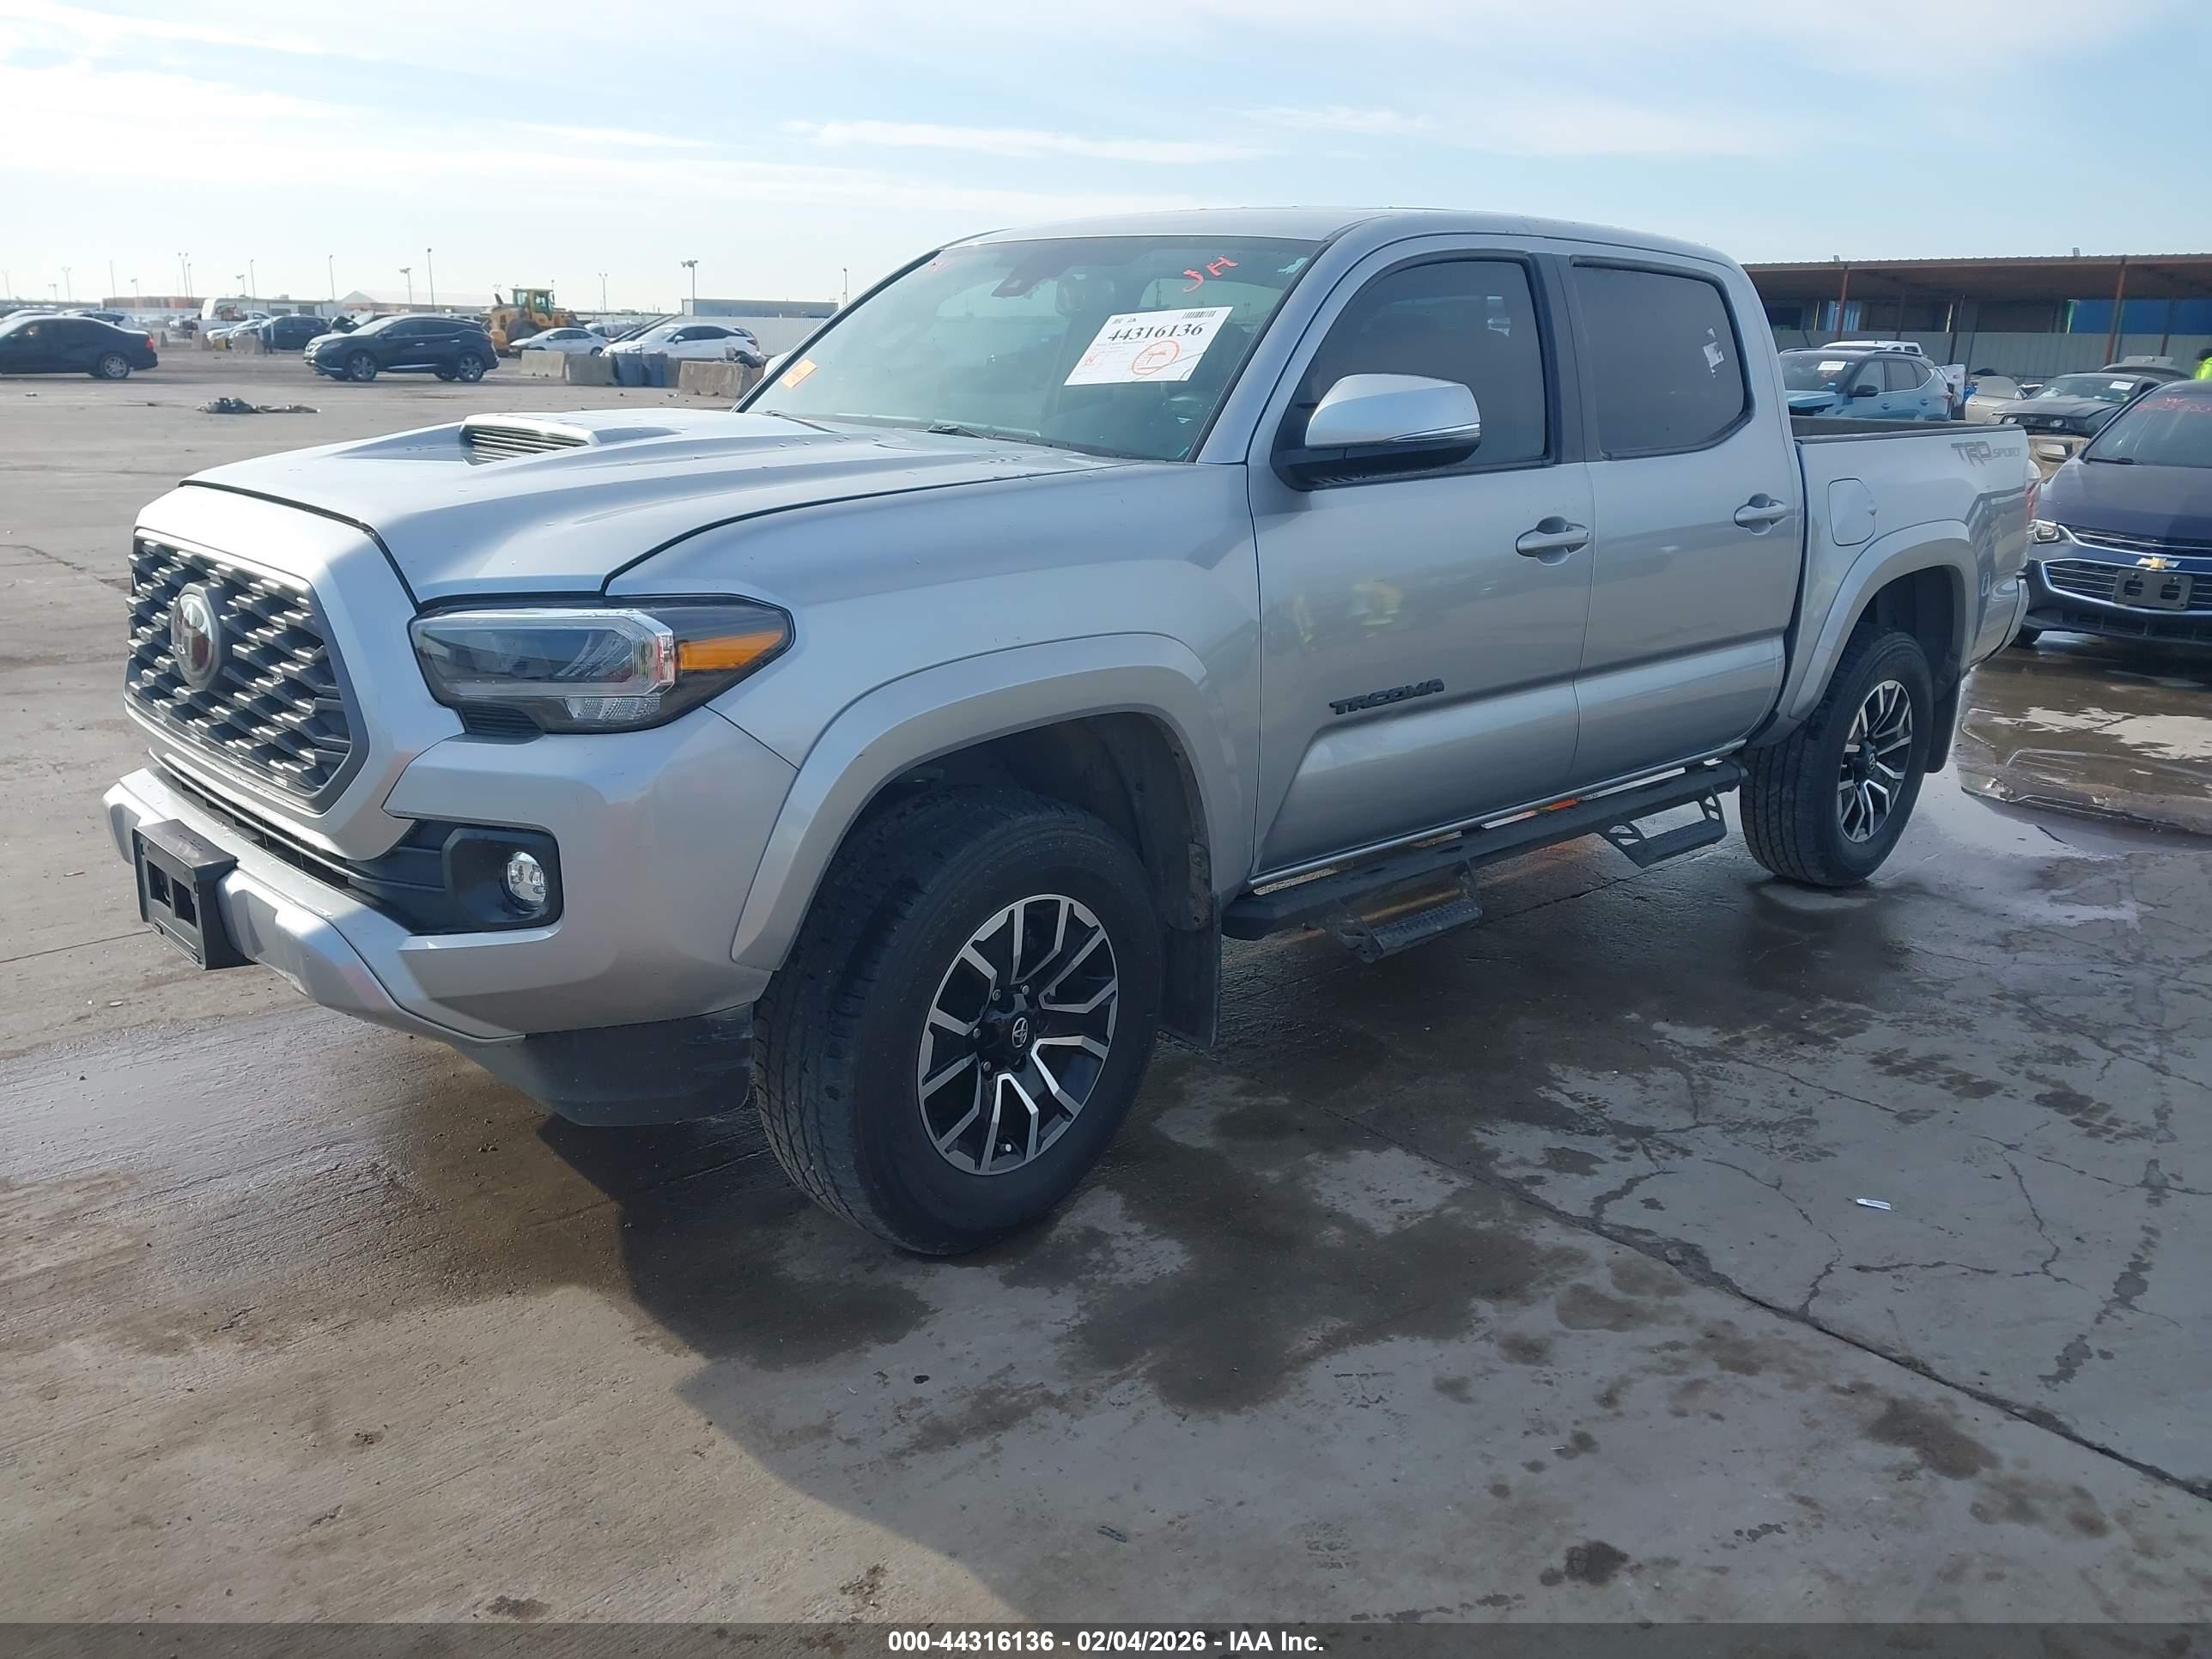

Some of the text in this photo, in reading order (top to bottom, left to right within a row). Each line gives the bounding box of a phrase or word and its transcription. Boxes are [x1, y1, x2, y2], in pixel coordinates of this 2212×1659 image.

[1107, 322, 1206, 343] 44316136
[1950, 441, 2021, 467] TRD SPORT
[1328, 678, 1445, 715] TACOMA
